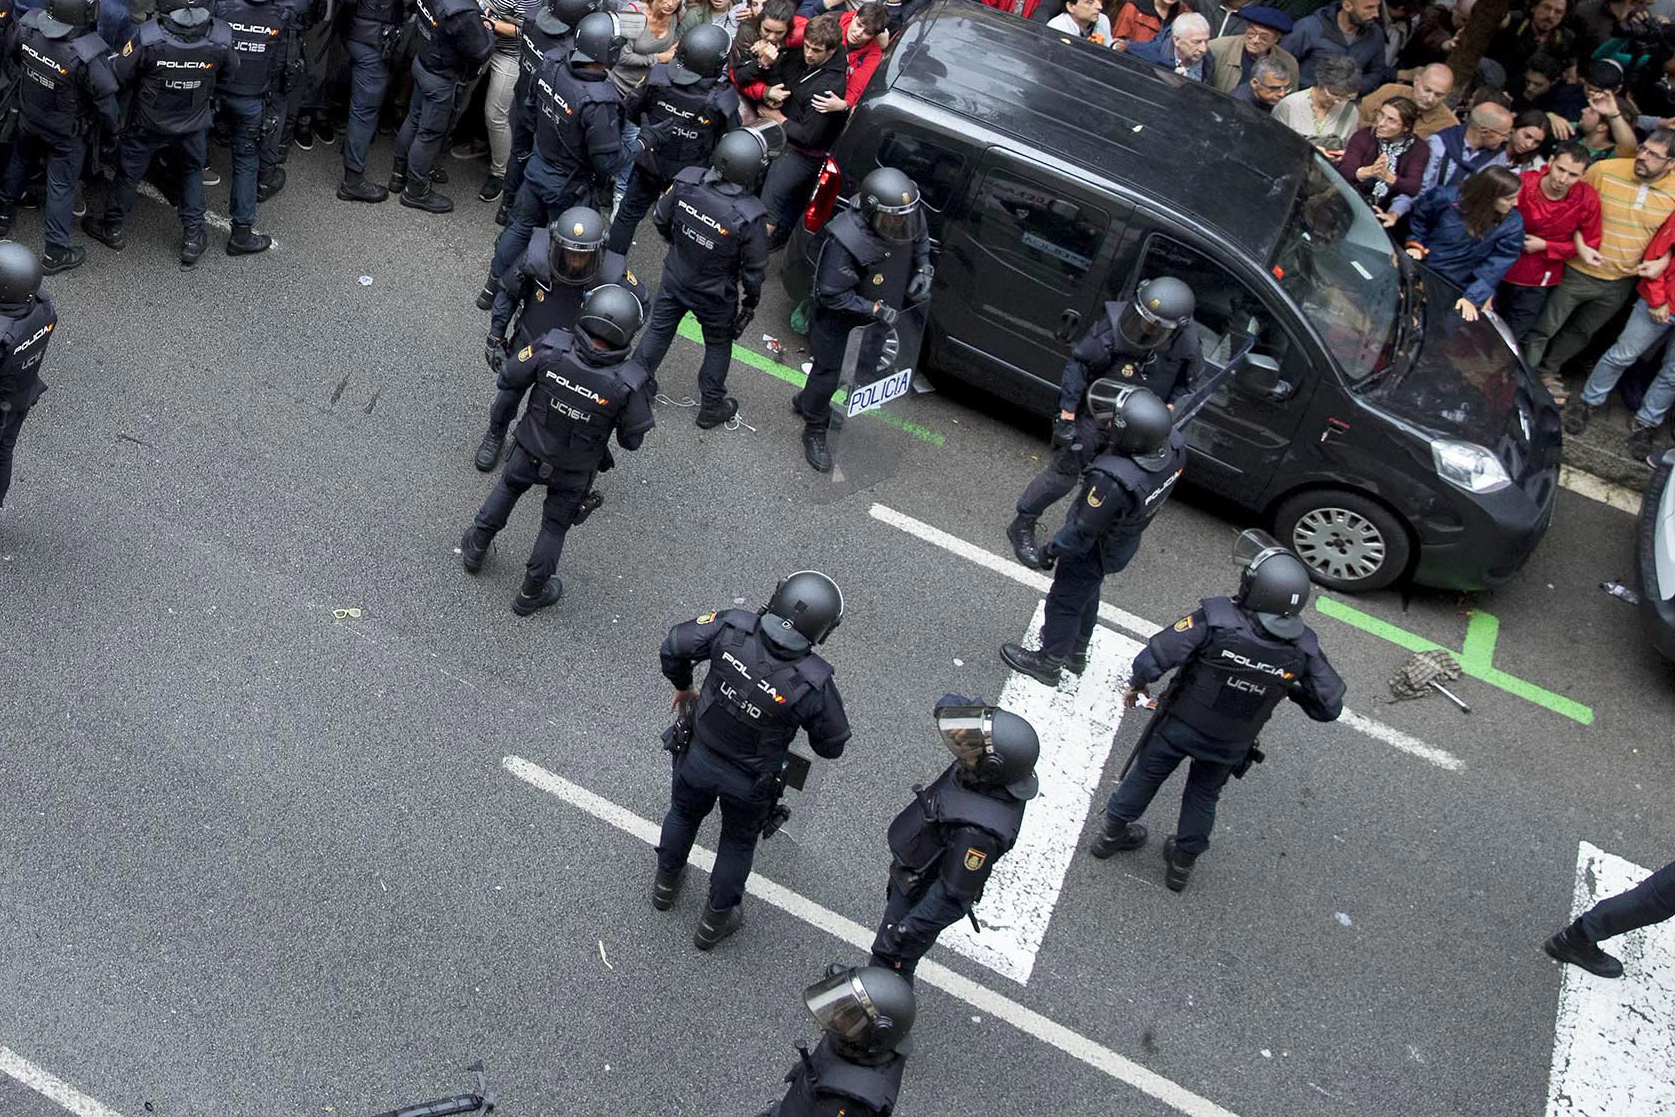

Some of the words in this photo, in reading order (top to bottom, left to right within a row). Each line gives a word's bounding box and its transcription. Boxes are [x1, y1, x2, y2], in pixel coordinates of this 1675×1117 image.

[21, 43, 62, 73] POLICIA
[523, 34, 545, 61] POLIC
[156, 60, 207, 70] POLICIA
[657, 100, 704, 125] POLICA
[678, 199, 722, 232] POLICIA
[13, 325, 49, 355] POLICIA
[546, 370, 600, 403] POLICIA
[850, 372, 908, 414] POLICIA
[550, 397, 591, 423] UC164
[1145, 471, 1180, 506] POLICIA
[1221, 649, 1286, 677] POLICIA
[1226, 676, 1266, 695] UC14
